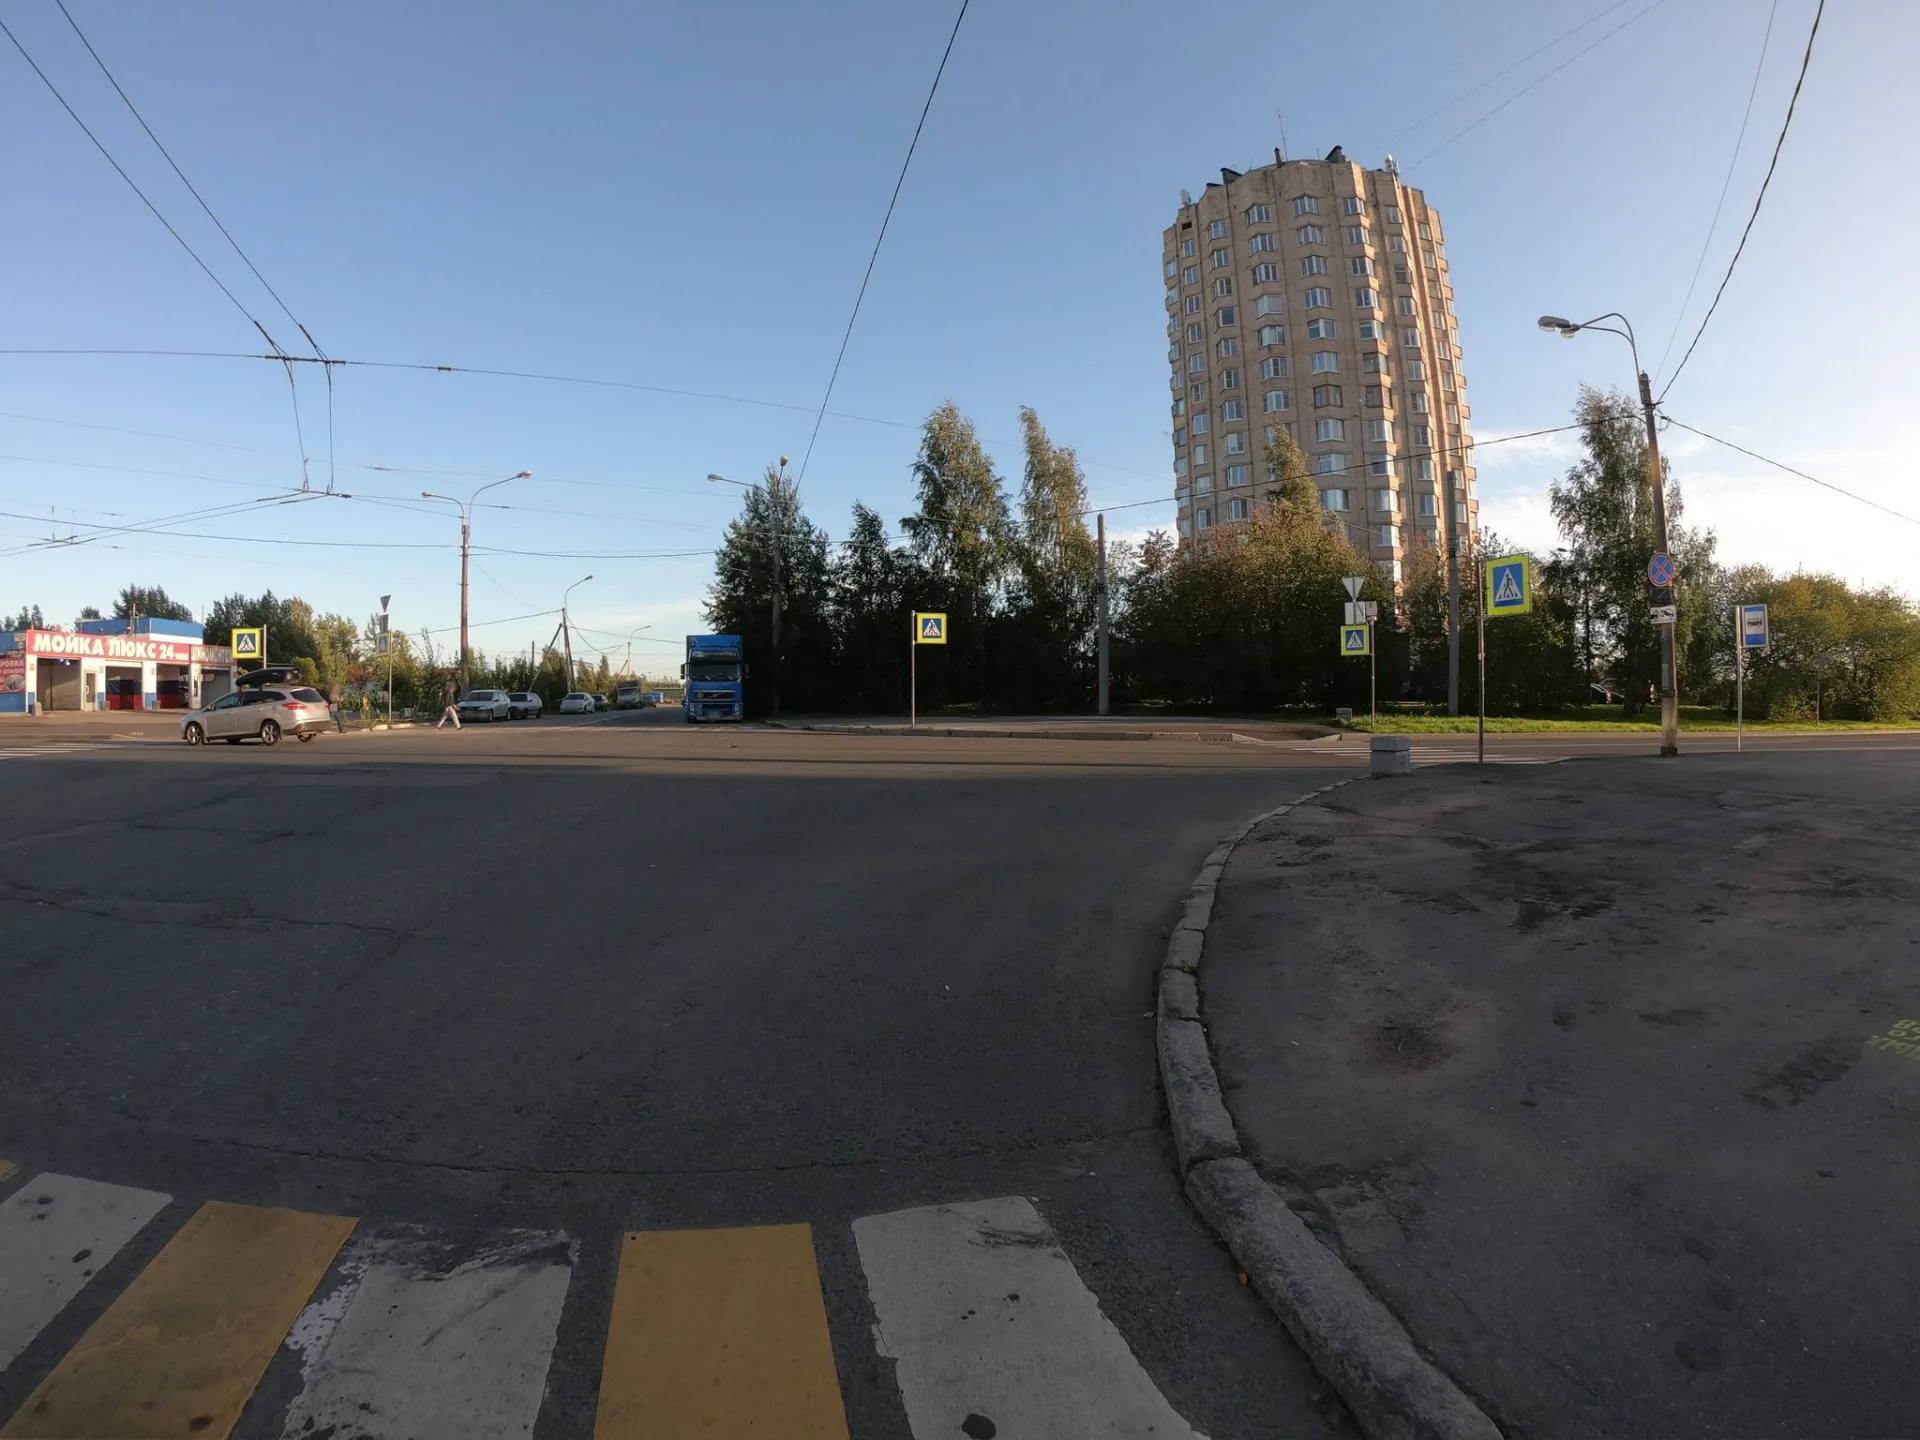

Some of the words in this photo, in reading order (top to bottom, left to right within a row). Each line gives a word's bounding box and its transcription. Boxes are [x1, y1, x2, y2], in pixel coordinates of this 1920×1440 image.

[33, 632, 105, 656] МОЙКА
[108, 638, 156, 659] ЛЮКС
[159, 644, 174, 660] 24
